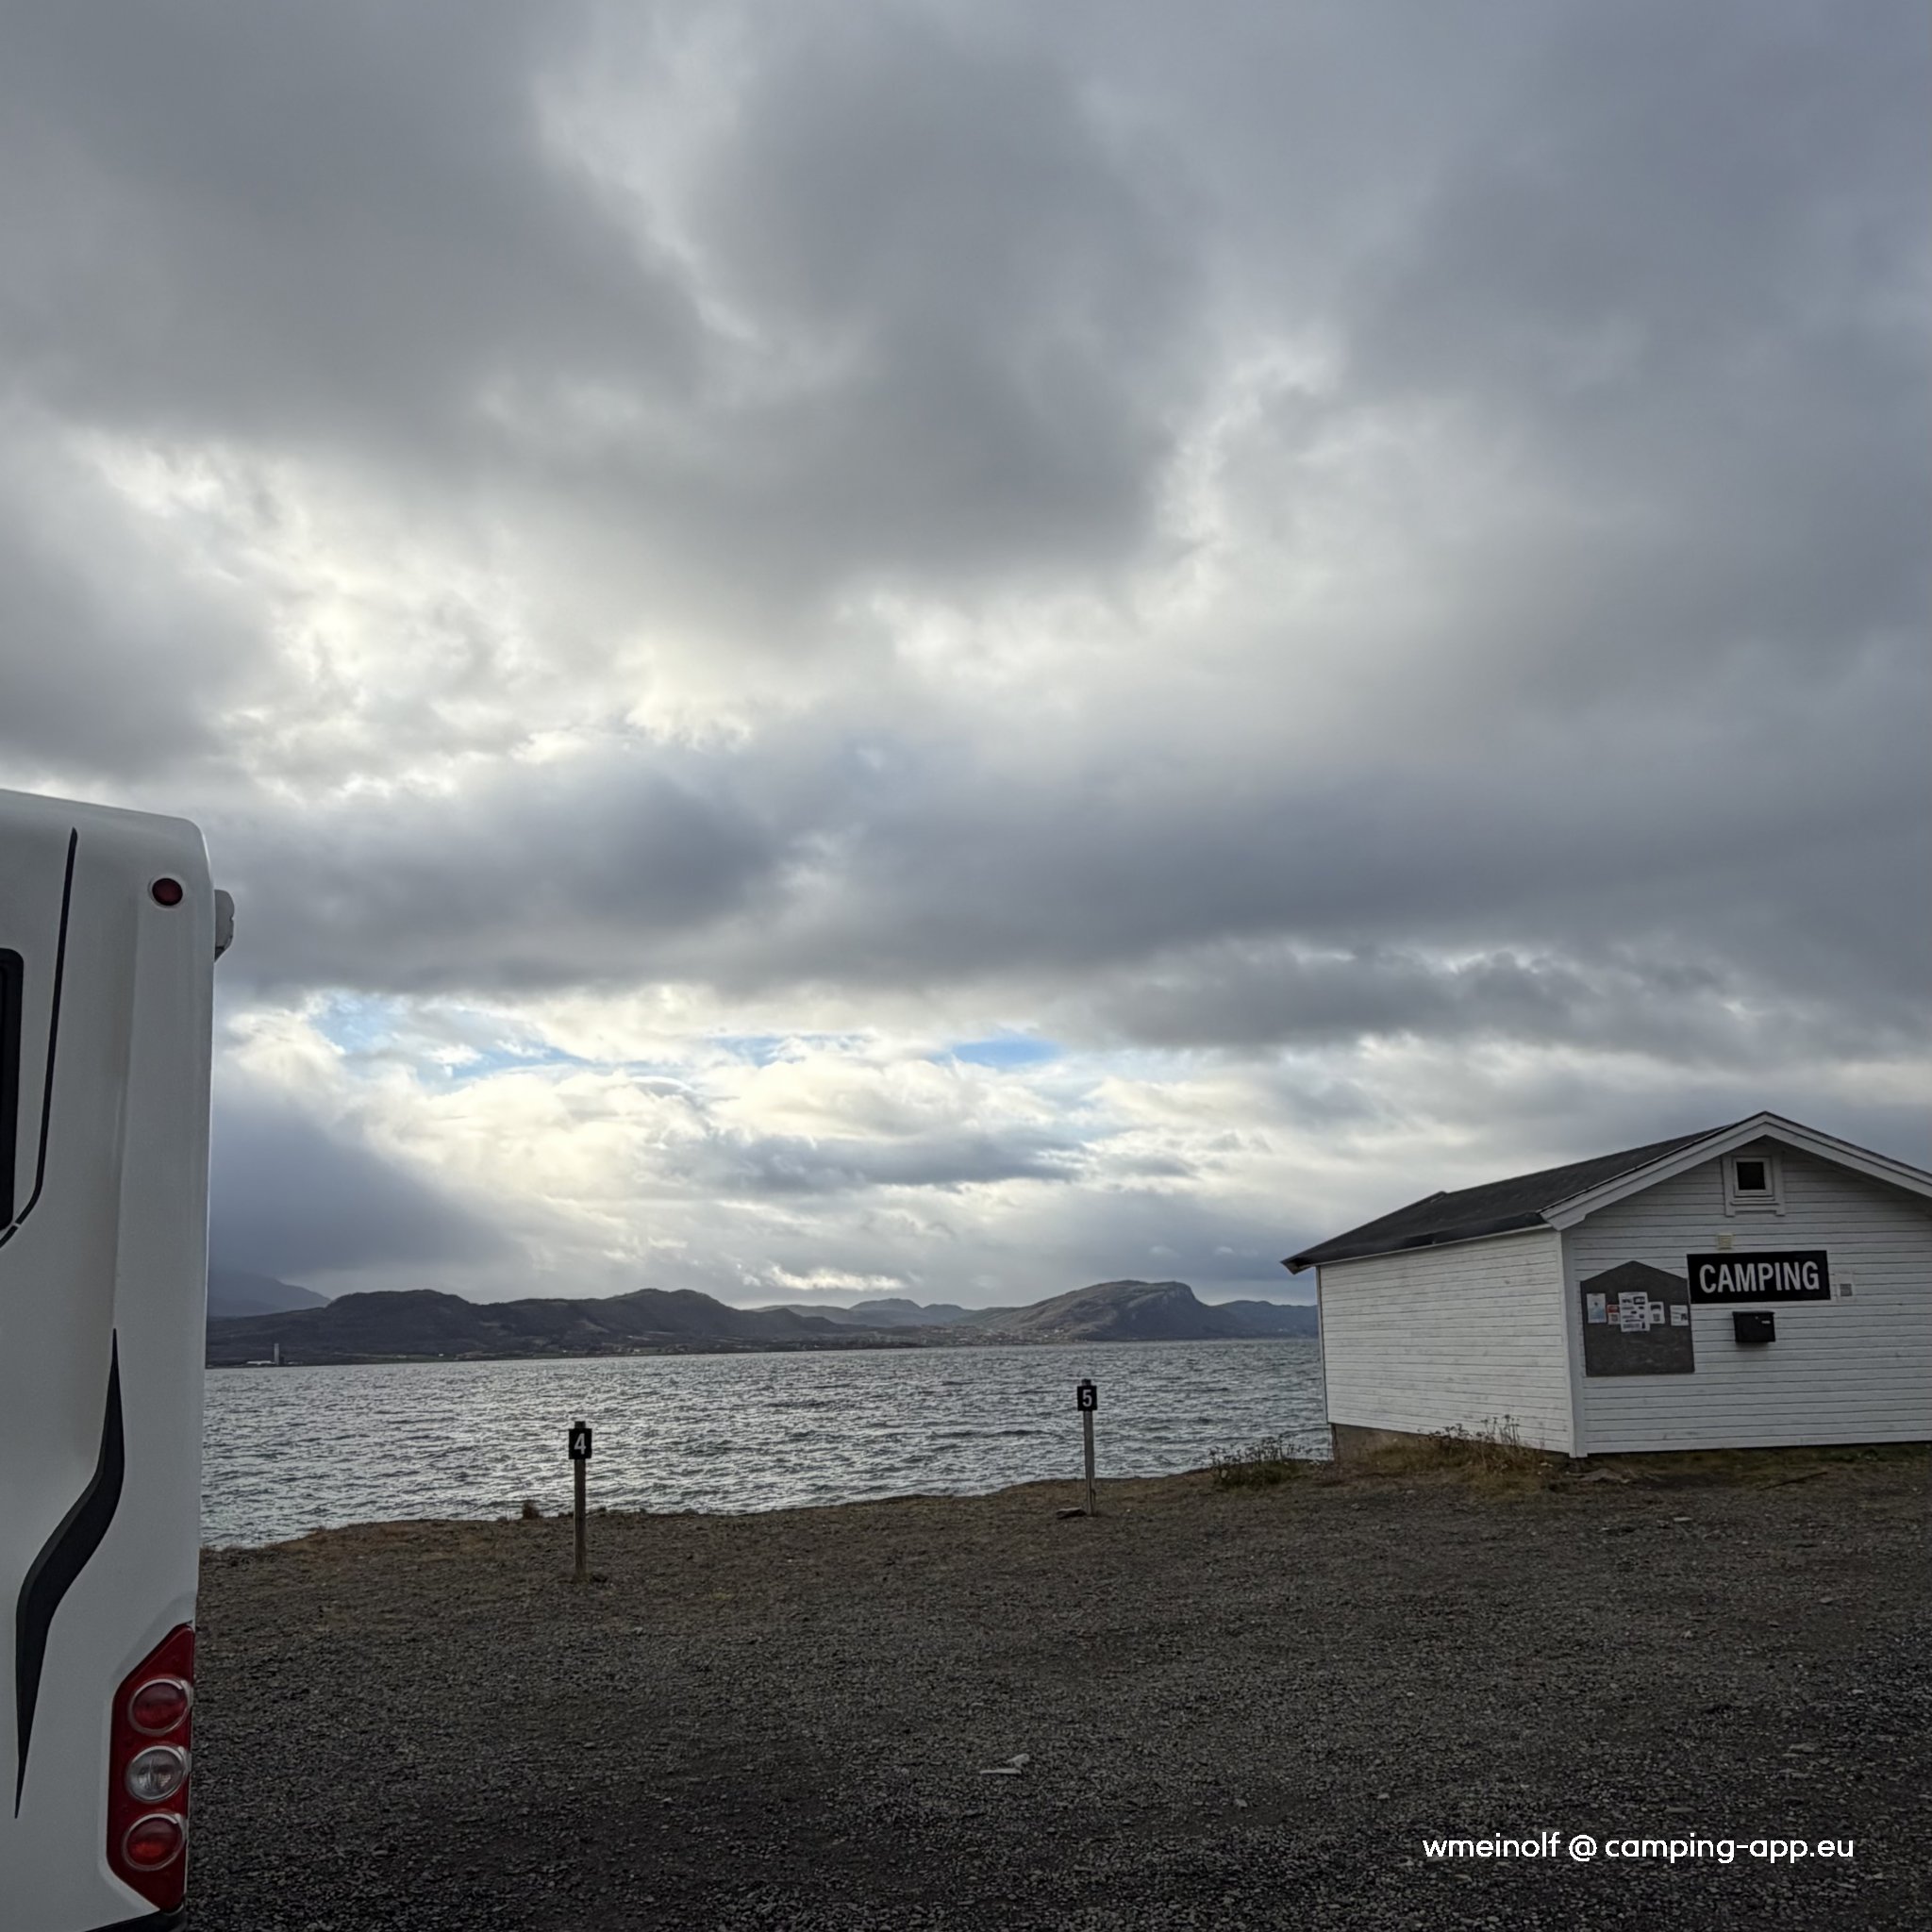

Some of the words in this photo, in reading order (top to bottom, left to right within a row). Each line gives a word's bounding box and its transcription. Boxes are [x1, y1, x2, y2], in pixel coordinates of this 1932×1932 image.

[1699, 1260, 1820, 1293] CAMPING
[1082, 1389, 1092, 1407] 5
[574, 1432, 587, 1455] 4
